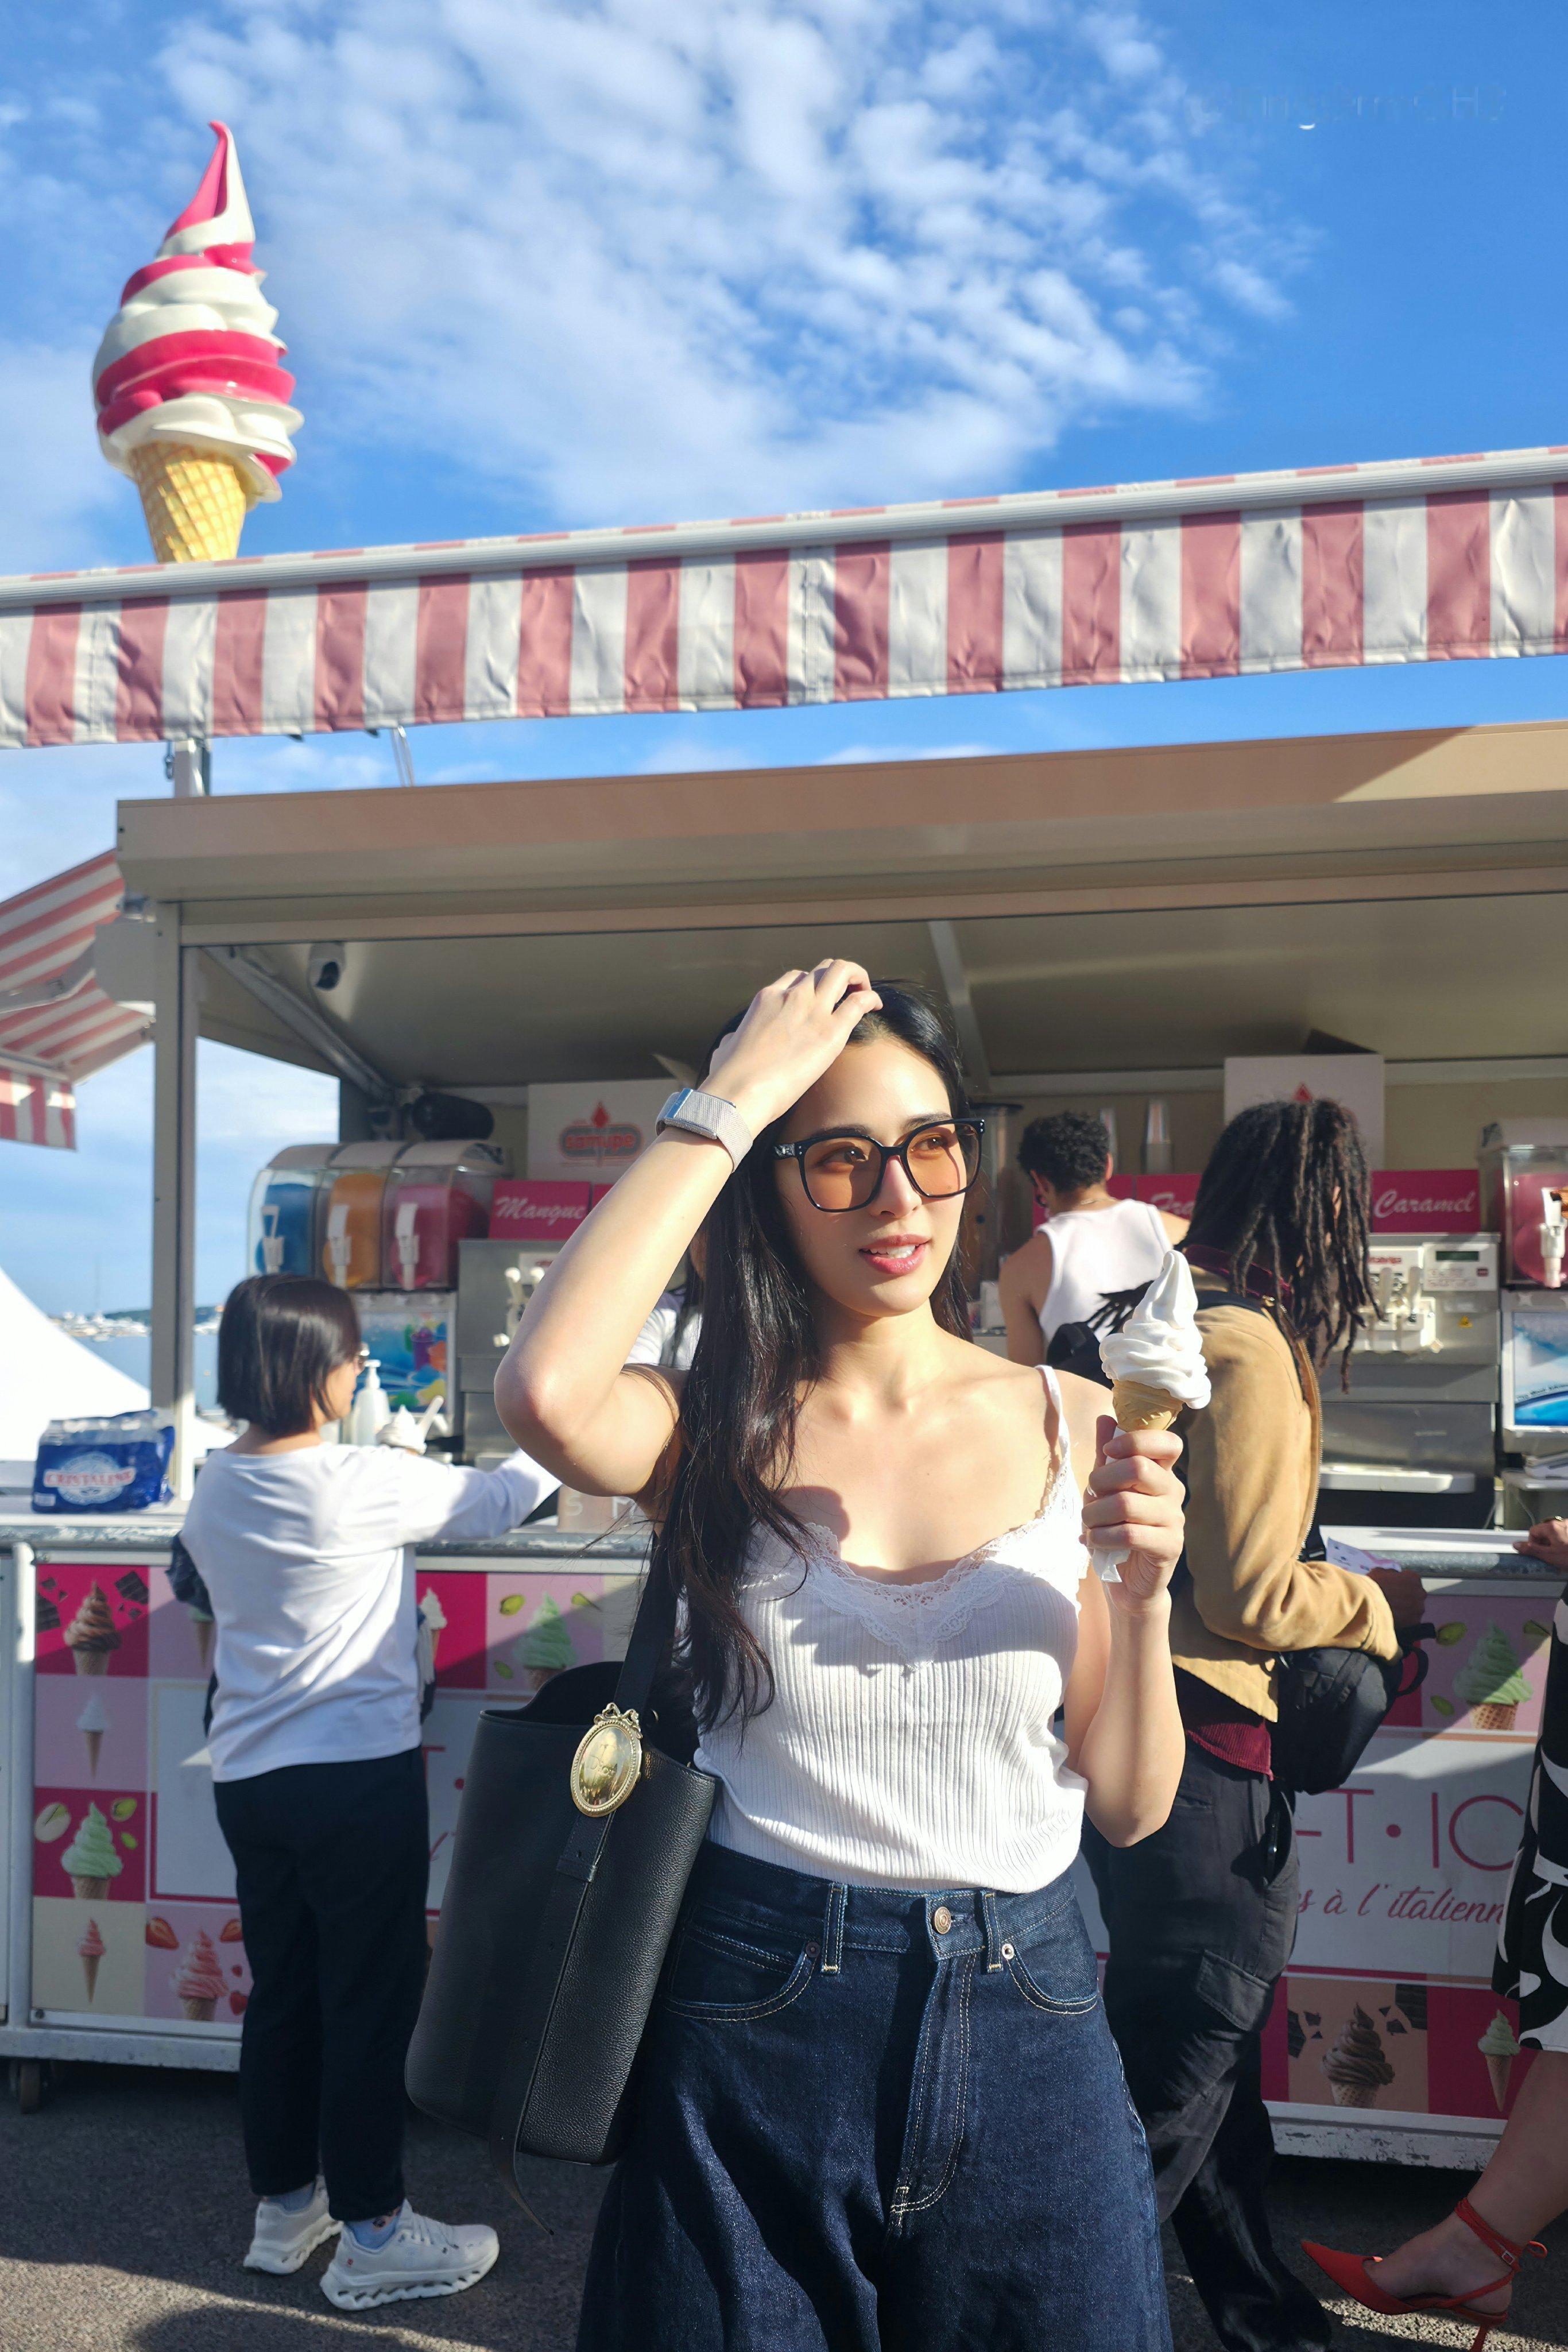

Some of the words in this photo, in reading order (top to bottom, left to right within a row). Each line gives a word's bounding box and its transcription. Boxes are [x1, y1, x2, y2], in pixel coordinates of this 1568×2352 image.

[1373, 1189, 1476, 1218] Caramel
[1431, 1791, 1526, 1872] IC
[1323, 1887, 1348, 1914] à
[1356, 1882, 1507, 1925] l'italienn
